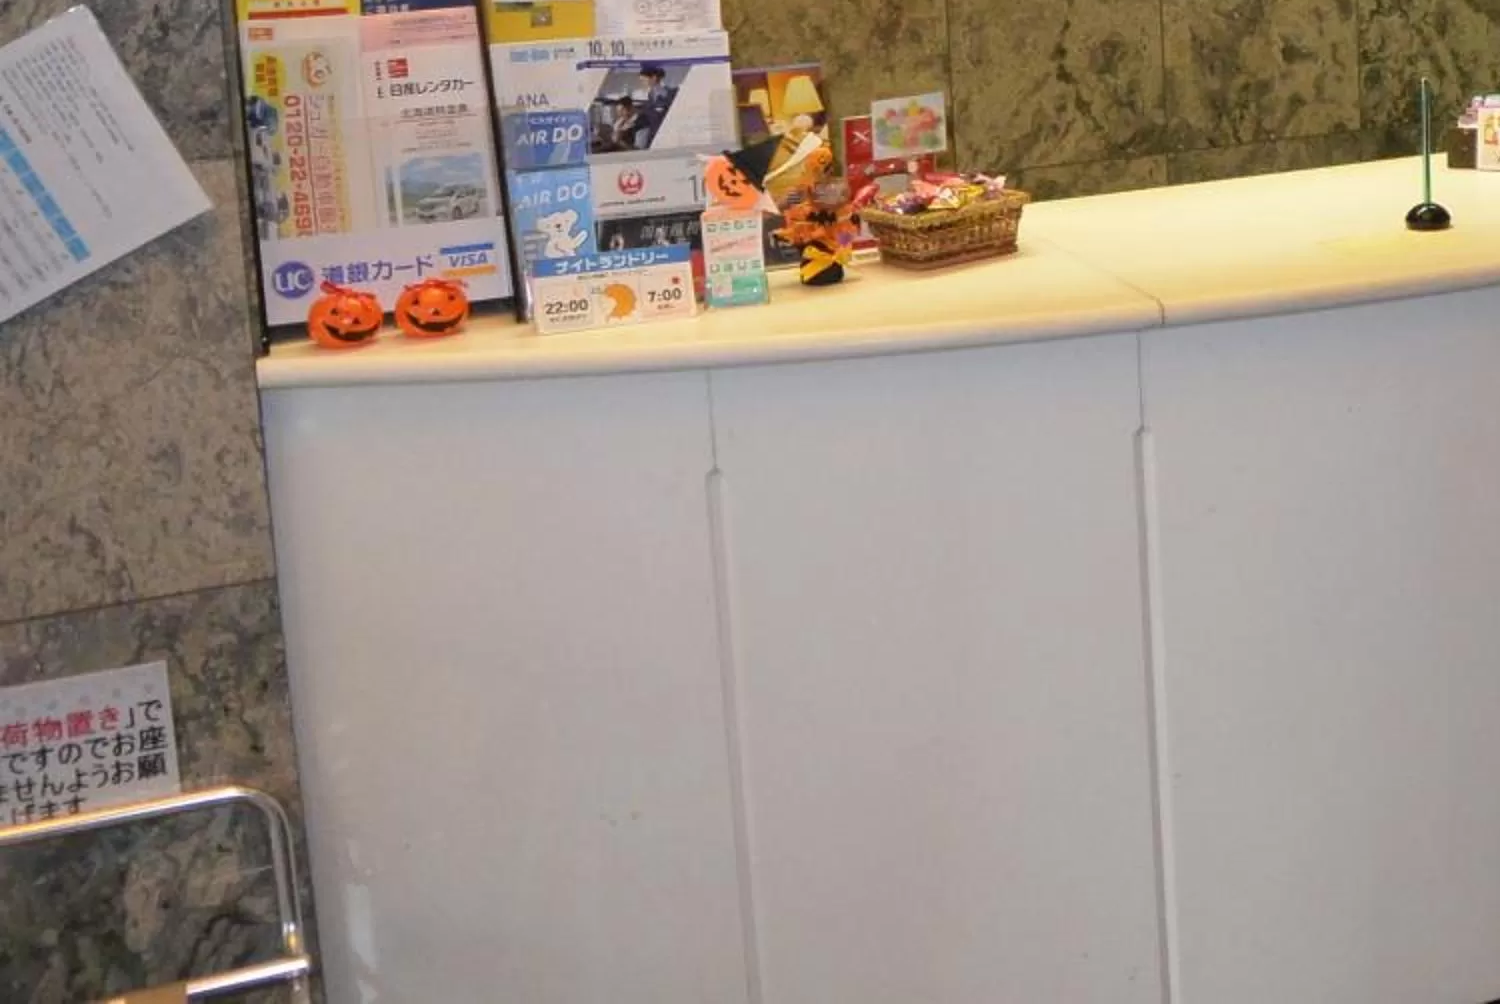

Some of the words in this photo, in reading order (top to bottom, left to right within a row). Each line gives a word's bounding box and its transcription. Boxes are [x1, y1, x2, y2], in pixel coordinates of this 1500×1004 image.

[389, 78, 475, 97] 日産レンタカー
[515, 92, 550, 106] ANA
[517, 128, 549, 146] AIR
[551, 123, 583, 144] DO
[520, 190, 552, 207] AIR
[556, 181, 588, 202] DO
[322, 254, 434, 284] 道銀カード
[449, 253, 490, 268] VISA
[555, 252, 670, 272] ナイトランドリー
[274, 270, 313, 292] UC
[647, 287, 682, 303] 7:00
[544, 299, 589, 315] 22:00
[1, 698, 163, 746] 荷物置き」で
[1, 725, 169, 775] ですのでお座
[0, 795, 87, 826] げます
